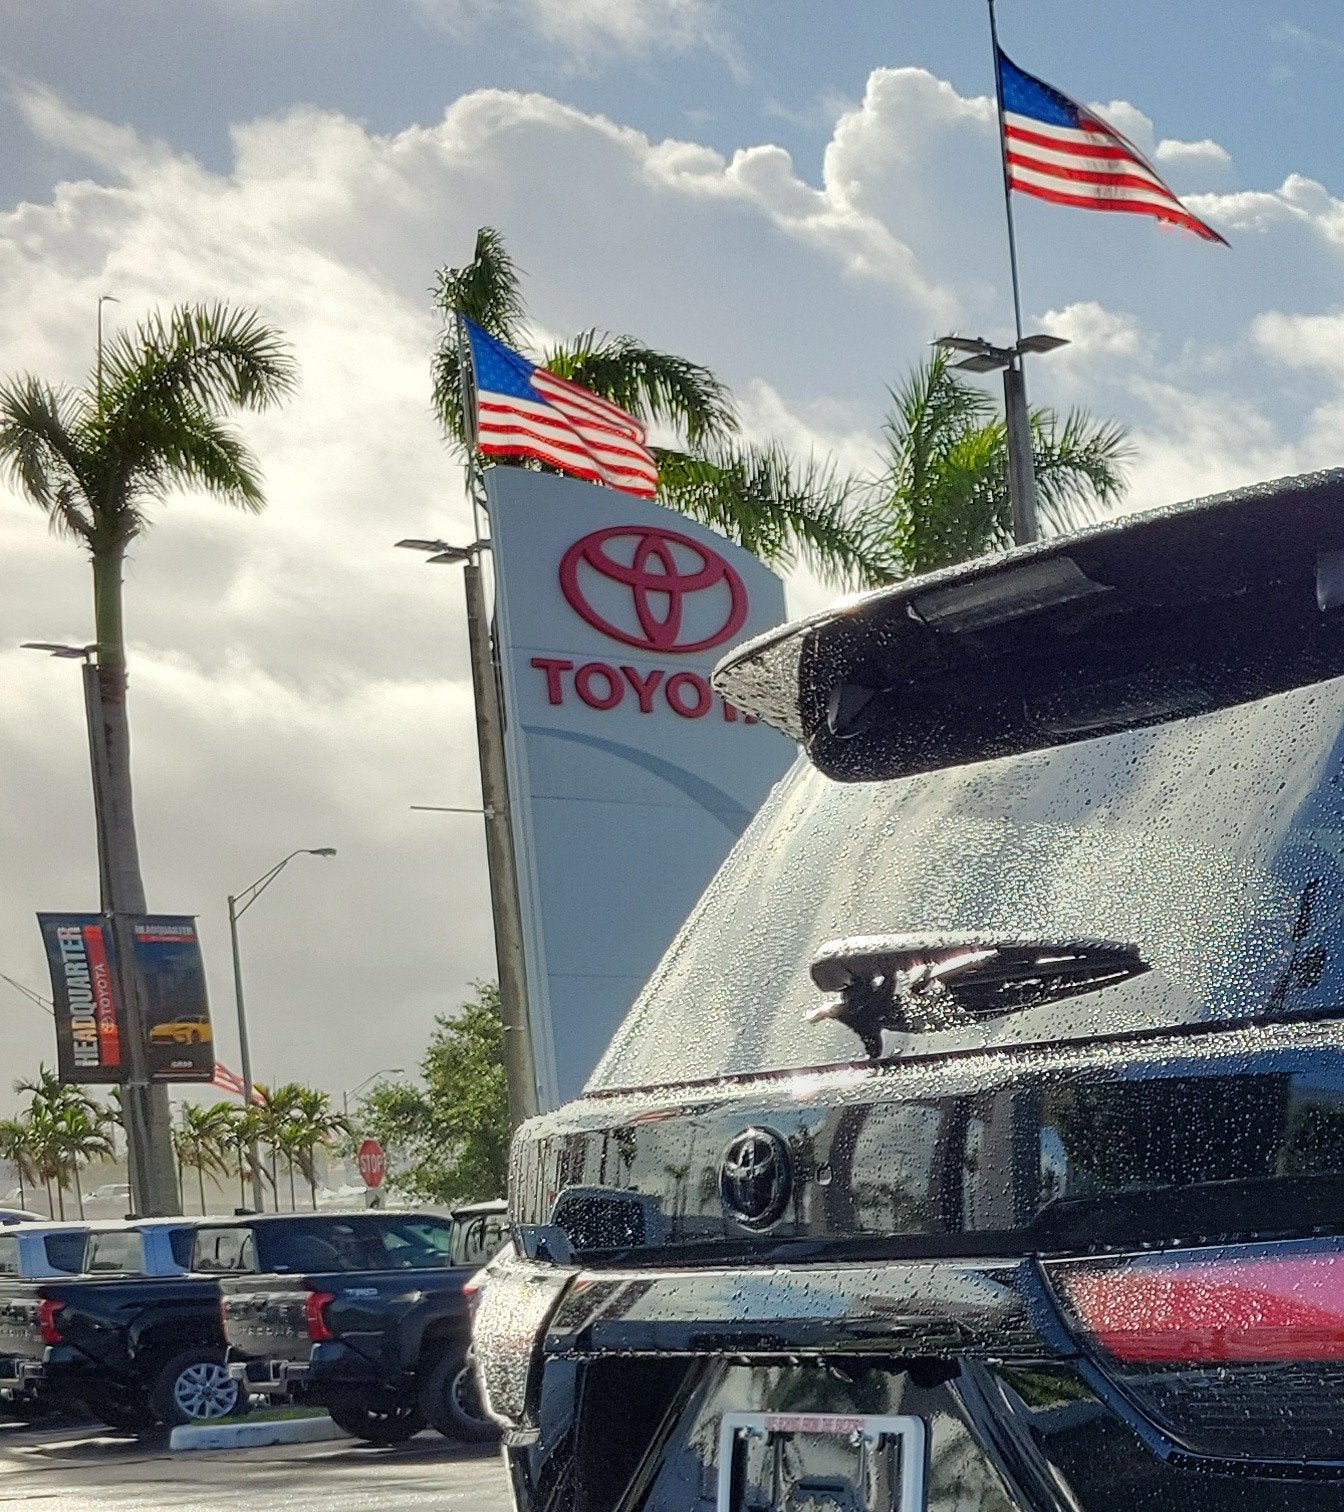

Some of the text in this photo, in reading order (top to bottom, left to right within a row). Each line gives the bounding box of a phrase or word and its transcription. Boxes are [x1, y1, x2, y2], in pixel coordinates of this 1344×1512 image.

[531, 658, 759, 724] TOYO
[57, 926, 100, 1067] HEADQUARTER
[93, 964, 112, 1017] TOYOTA
[360, 1154, 384, 1174] STOP
